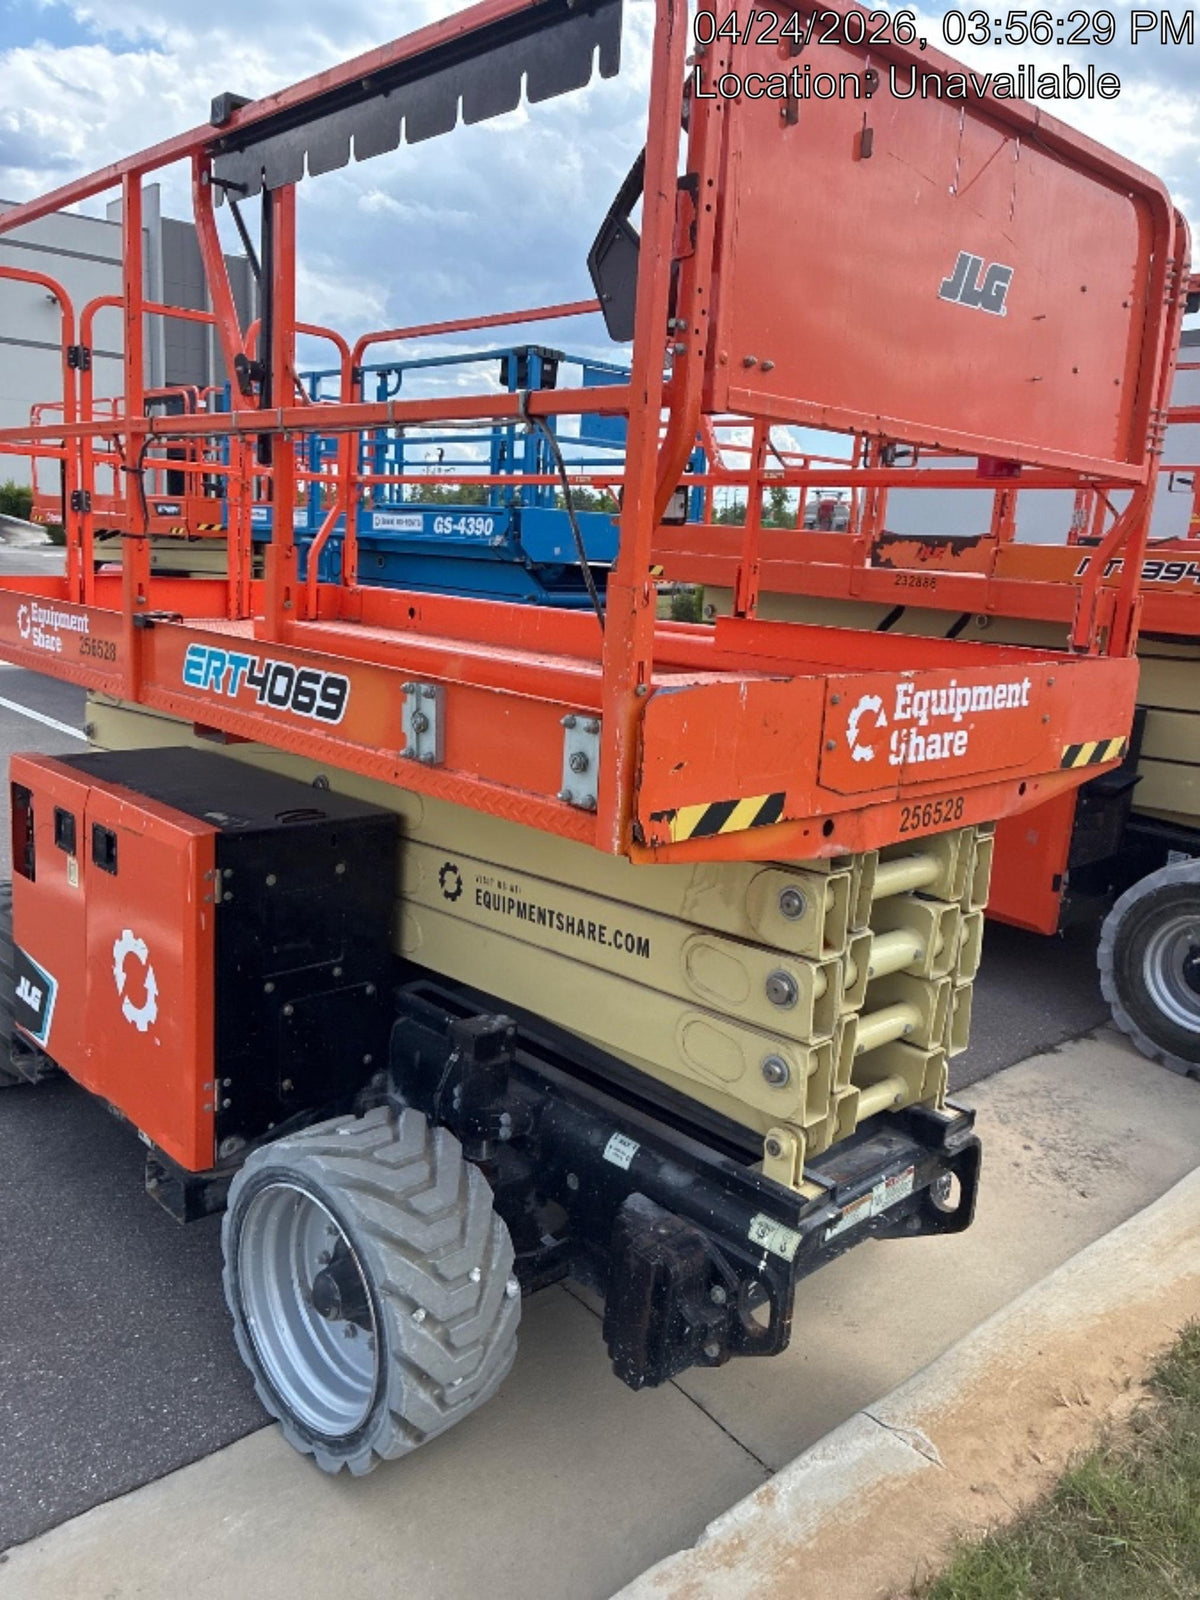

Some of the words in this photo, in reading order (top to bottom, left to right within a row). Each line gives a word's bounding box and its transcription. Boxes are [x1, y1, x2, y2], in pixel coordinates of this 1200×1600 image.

[938, 249, 1014, 317] JLG
[433, 516, 494, 536] GS-4390
[30, 602, 90, 633] Equipment
[31, 626, 62, 653] Share
[183, 643, 350, 725] ERT4069
[893, 677, 1032, 726] Equipment
[888, 726, 968, 766] Share
[899, 796, 964, 833] 256528
[475, 888, 650, 959] EQUIPMENTSHARE.COM
[15, 975, 43, 1013] JLG
